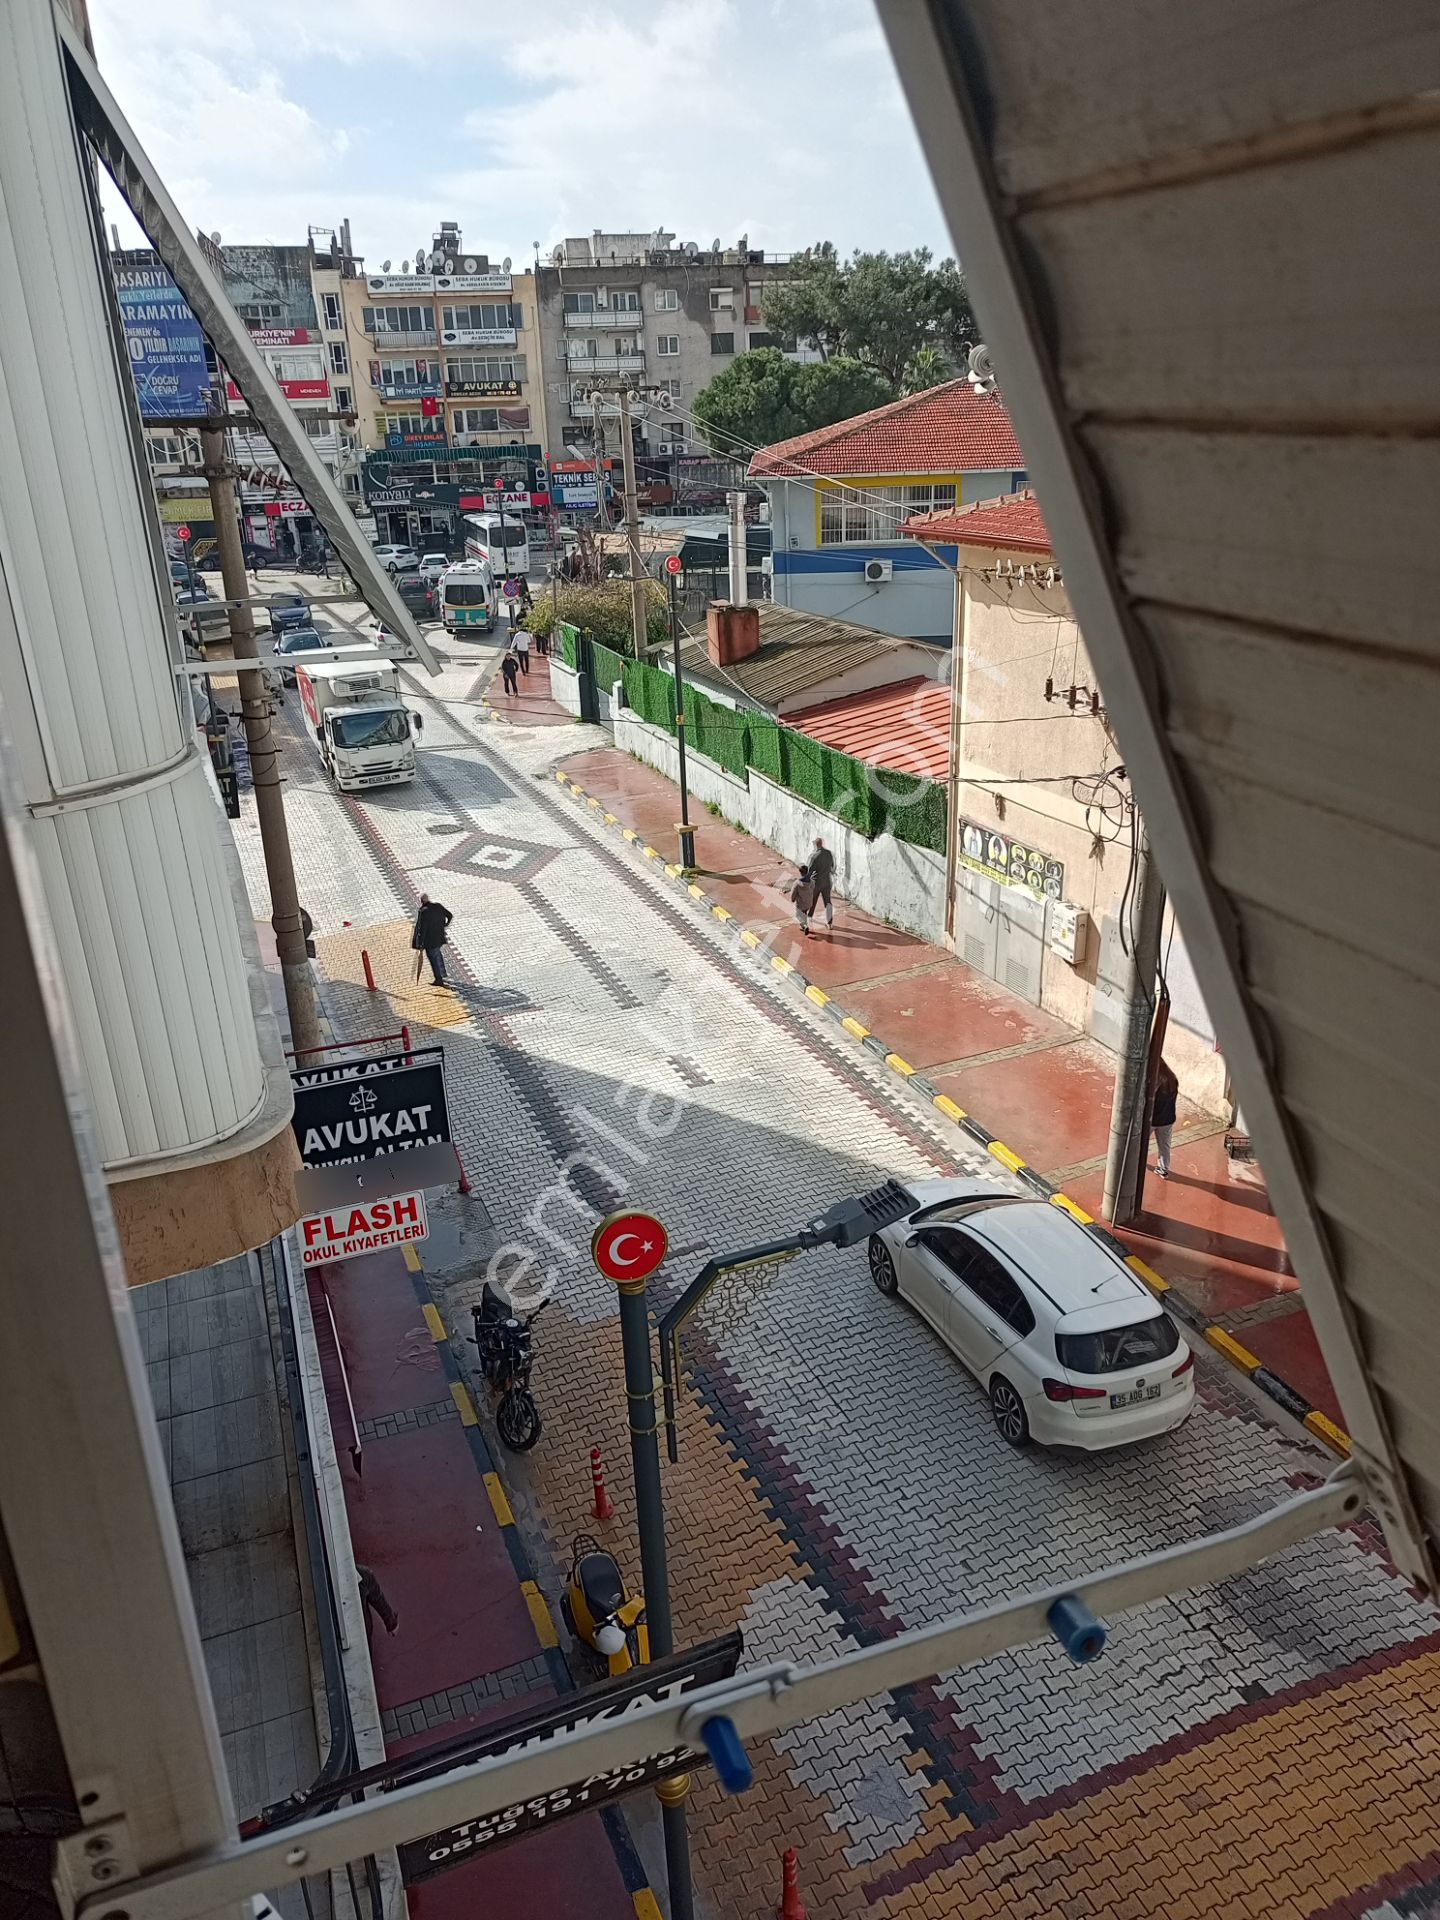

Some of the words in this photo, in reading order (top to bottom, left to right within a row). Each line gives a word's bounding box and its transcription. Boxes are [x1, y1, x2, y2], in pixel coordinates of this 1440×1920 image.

[151, 374, 179, 386] DOĞRU
[153, 385, 178, 395] CEVAP
[463, 382, 503, 391] AVUKAT
[554, 472, 583, 484] TEKNİK
[486, 493, 528, 504] ECZANE
[303, 1104, 432, 1155] AVUKAT
[302, 1197, 418, 1246] FLASH
[303, 1243, 340, 1263] OKUL
[343, 1220, 425, 1254] KIYAFETLERİ
[428, 1820, 517, 1861] 0555
[532, 1789, 590, 1819] 191
[605, 1767, 646, 1791] 70
[656, 1748, 699, 1770] 92
[451, 1788, 569, 1838] Tuğçe
